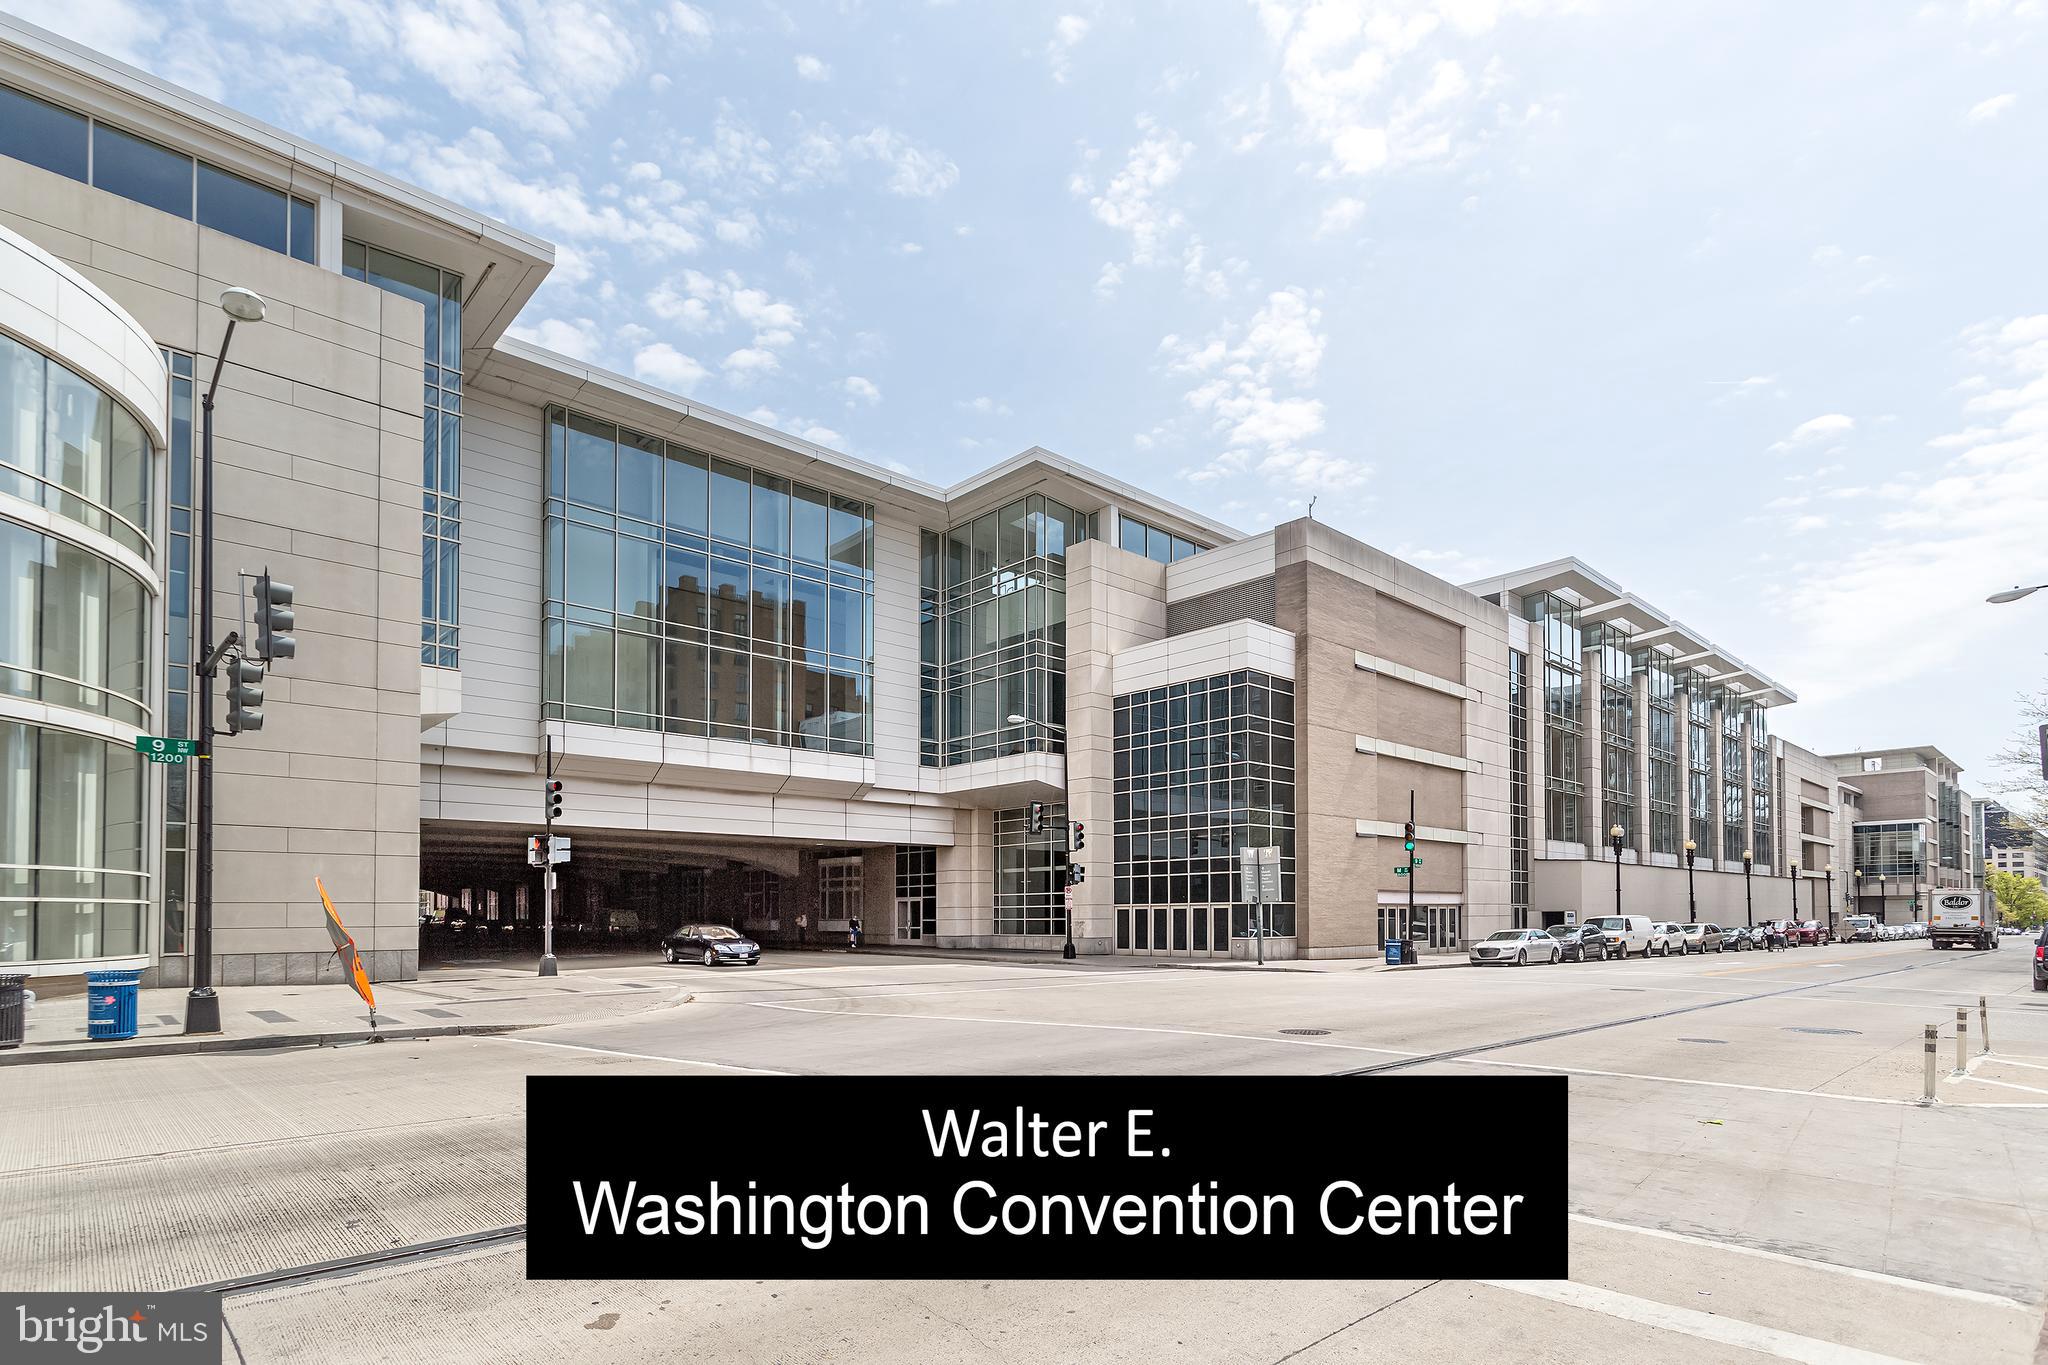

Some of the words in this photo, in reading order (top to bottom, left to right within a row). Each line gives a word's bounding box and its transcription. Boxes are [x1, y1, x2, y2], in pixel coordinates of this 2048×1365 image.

[152, 739, 166, 752] 9
[150, 752, 183, 763] 1200
[1943, 897, 1970, 906] Baldor
